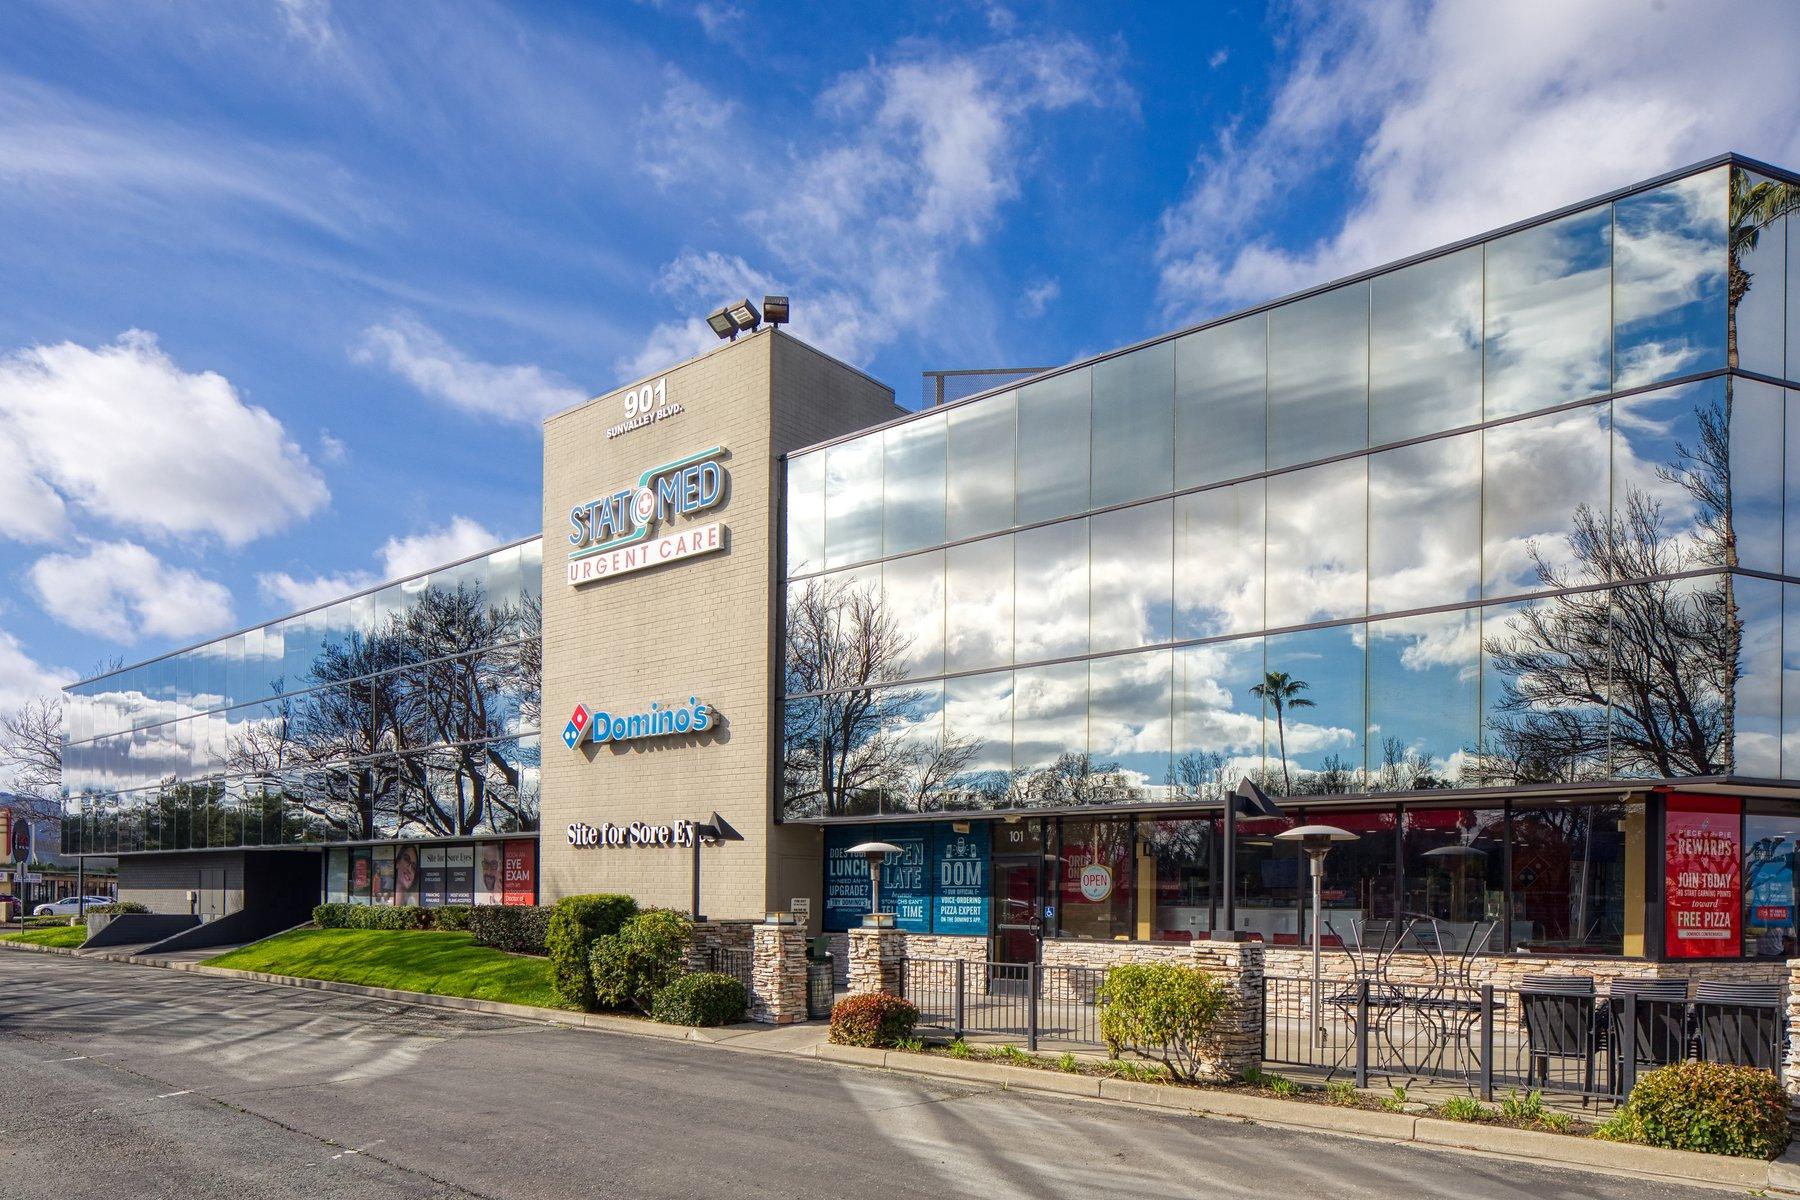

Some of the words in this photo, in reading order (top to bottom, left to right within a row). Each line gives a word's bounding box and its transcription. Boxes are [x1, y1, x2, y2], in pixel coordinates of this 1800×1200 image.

[624, 377, 668, 420] 901
[606, 411, 655, 439] SUNVALLEY
[656, 402, 684, 421] BLVD.
[570, 545, 649, 582] URGENT
[659, 526, 717, 559] CARE
[592, 695, 710, 744] Domino's
[567, 822, 598, 846] Site
[600, 822, 627, 845] for
[629, 820, 669, 844] Sore
[1009, 830, 1024, 843] 101
[1678, 829, 1702, 838] PIECE
[1719, 831, 1732, 839] PIE
[829, 848, 848, 858] DOES
[883, 843, 924, 866] OPEN
[1678, 838, 1732, 856] REWARDS
[506, 859, 522, 870] EYE
[829, 859, 868, 876] LUNCH
[506, 870, 530, 881] EXAM
[883, 866, 922, 889] LATE
[941, 861, 982, 886] DOM
[1083, 874, 1107, 887] OPEN
[1678, 872, 1699, 888] JOIN
[1701, 872, 1732, 889] TODAY
[829, 884, 869, 896] UPGRADE?
[902, 905, 923, 918] TIME
[941, 905, 958, 915] PIZZA
[959, 905, 981, 916] EXPERT
[1691, 899, 1719, 908] toward
[1677, 911, 1701, 927] FREE
[1704, 911, 1731, 928] PIZZA
